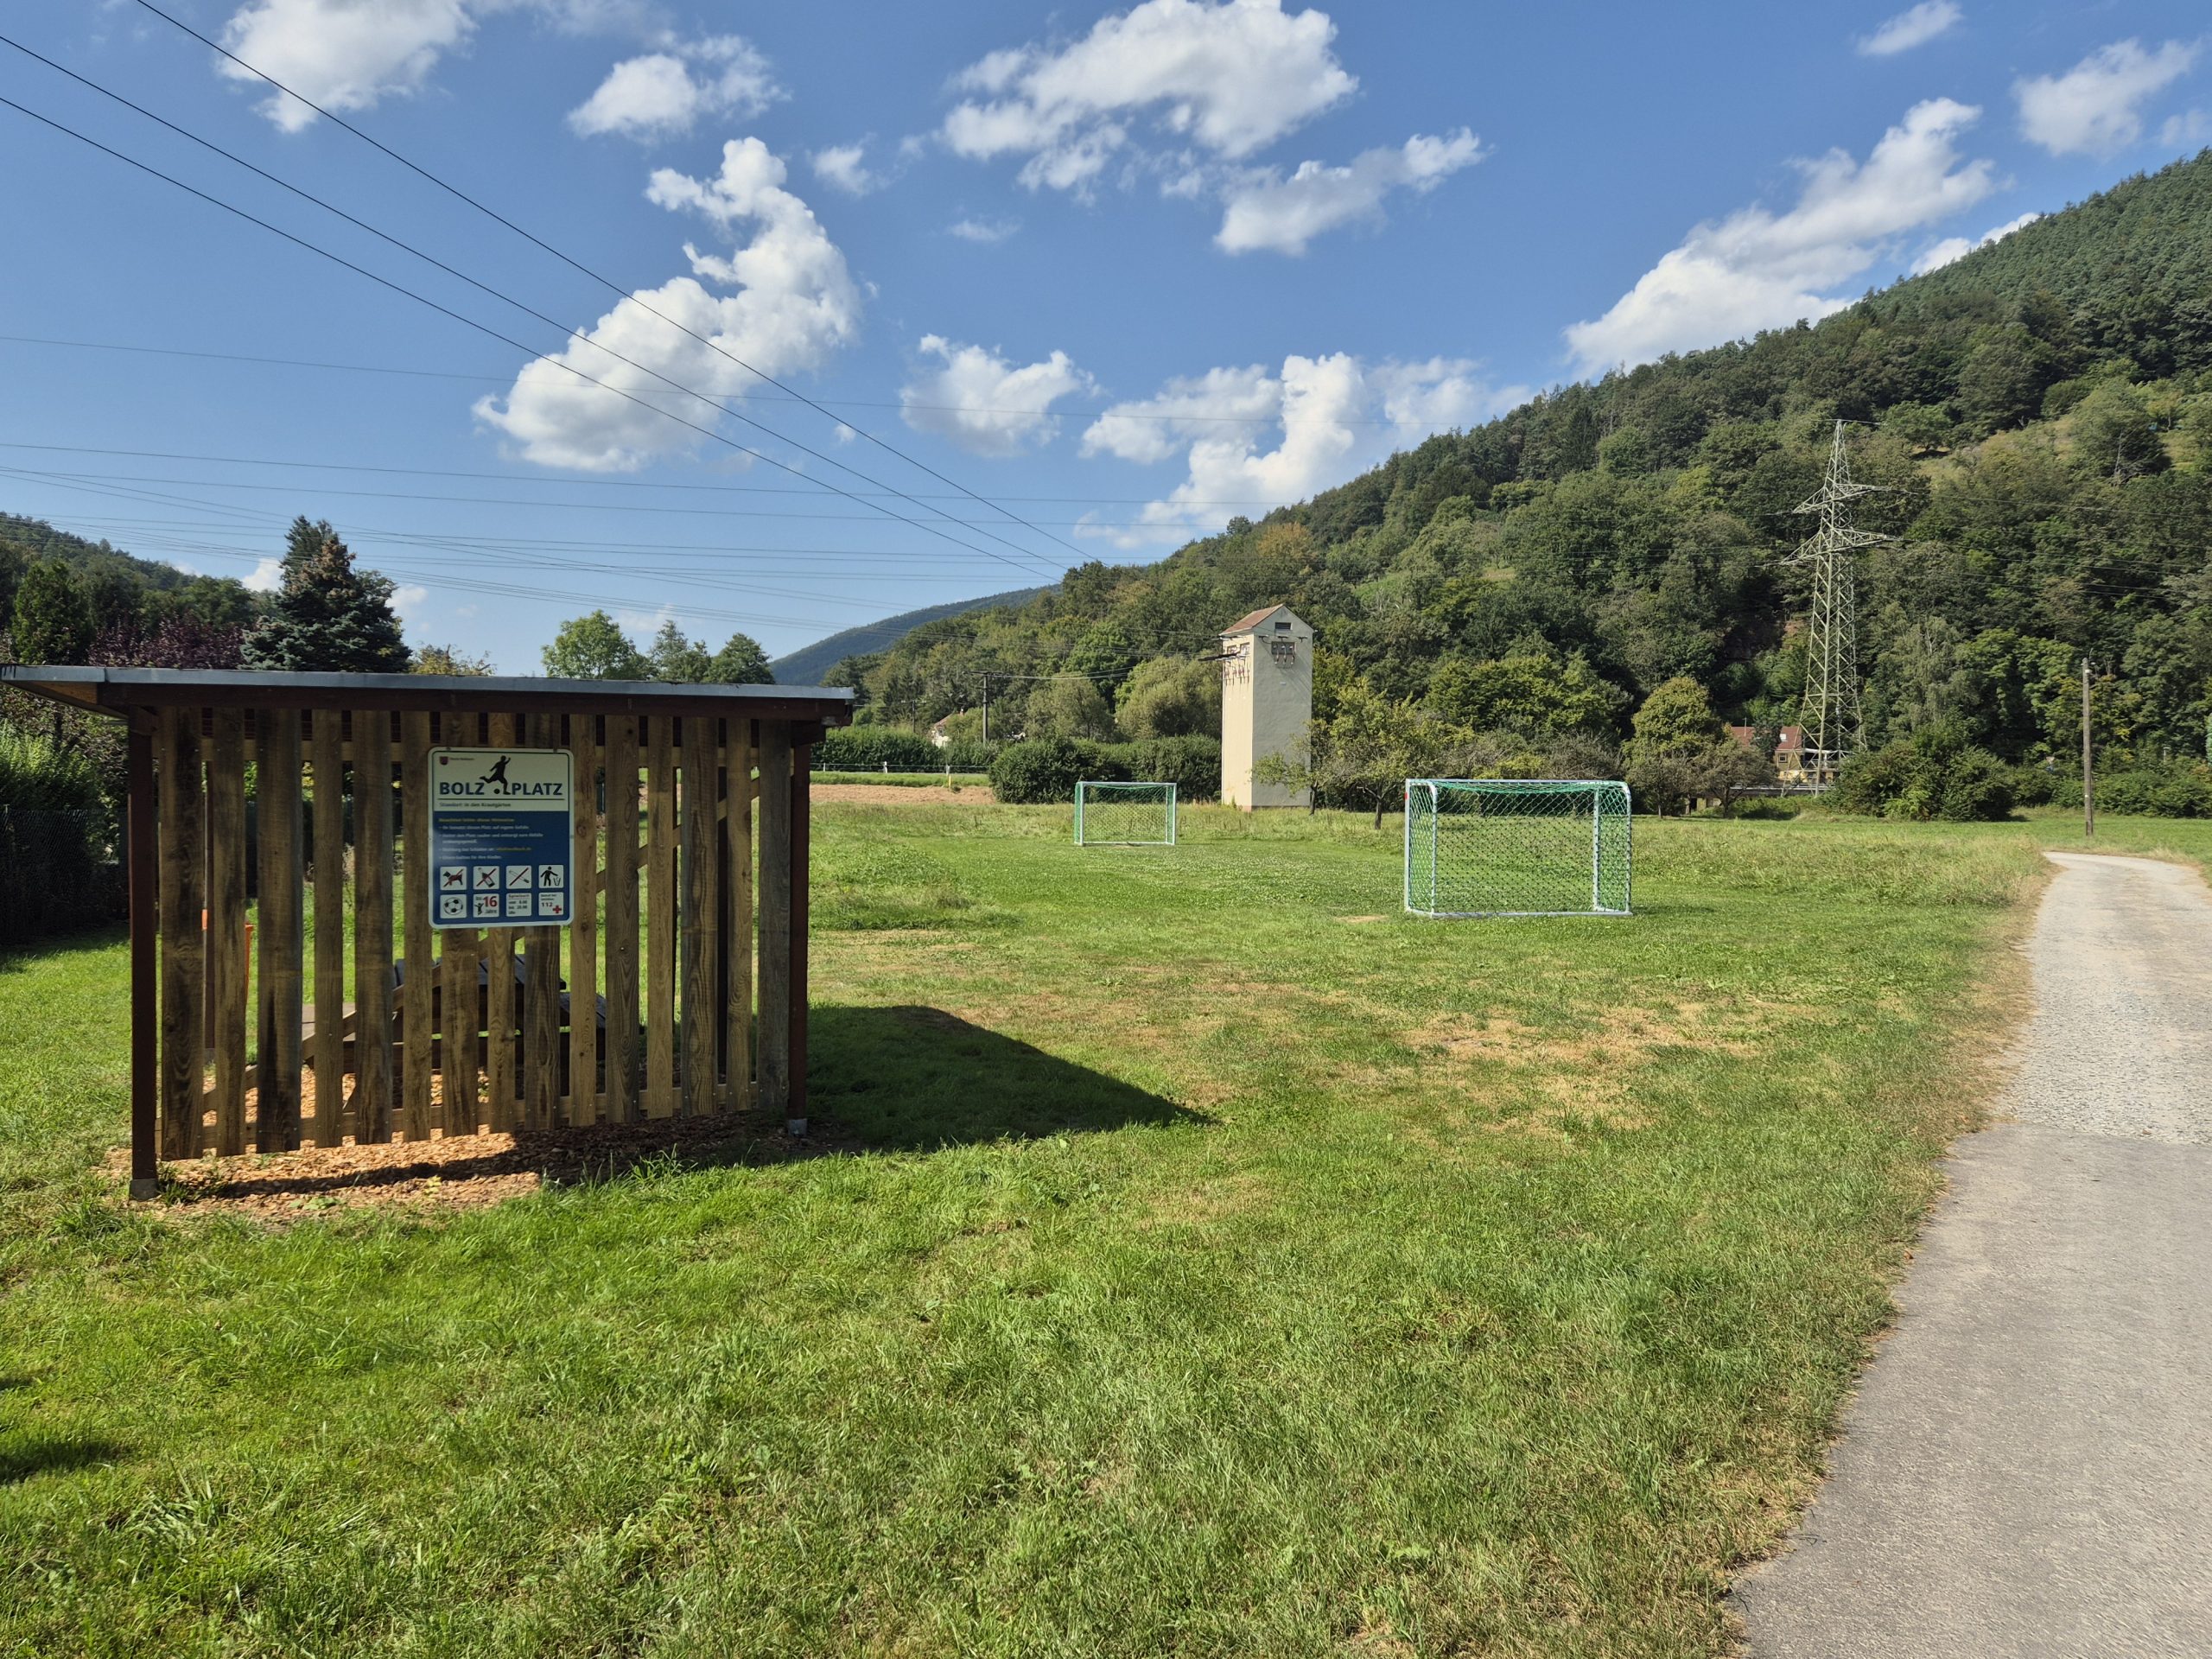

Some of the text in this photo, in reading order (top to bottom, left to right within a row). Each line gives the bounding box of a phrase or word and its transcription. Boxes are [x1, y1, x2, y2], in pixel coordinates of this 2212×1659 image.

[439, 782, 563, 795] BOLZ PLATZ
[483, 895, 498, 907] 16
